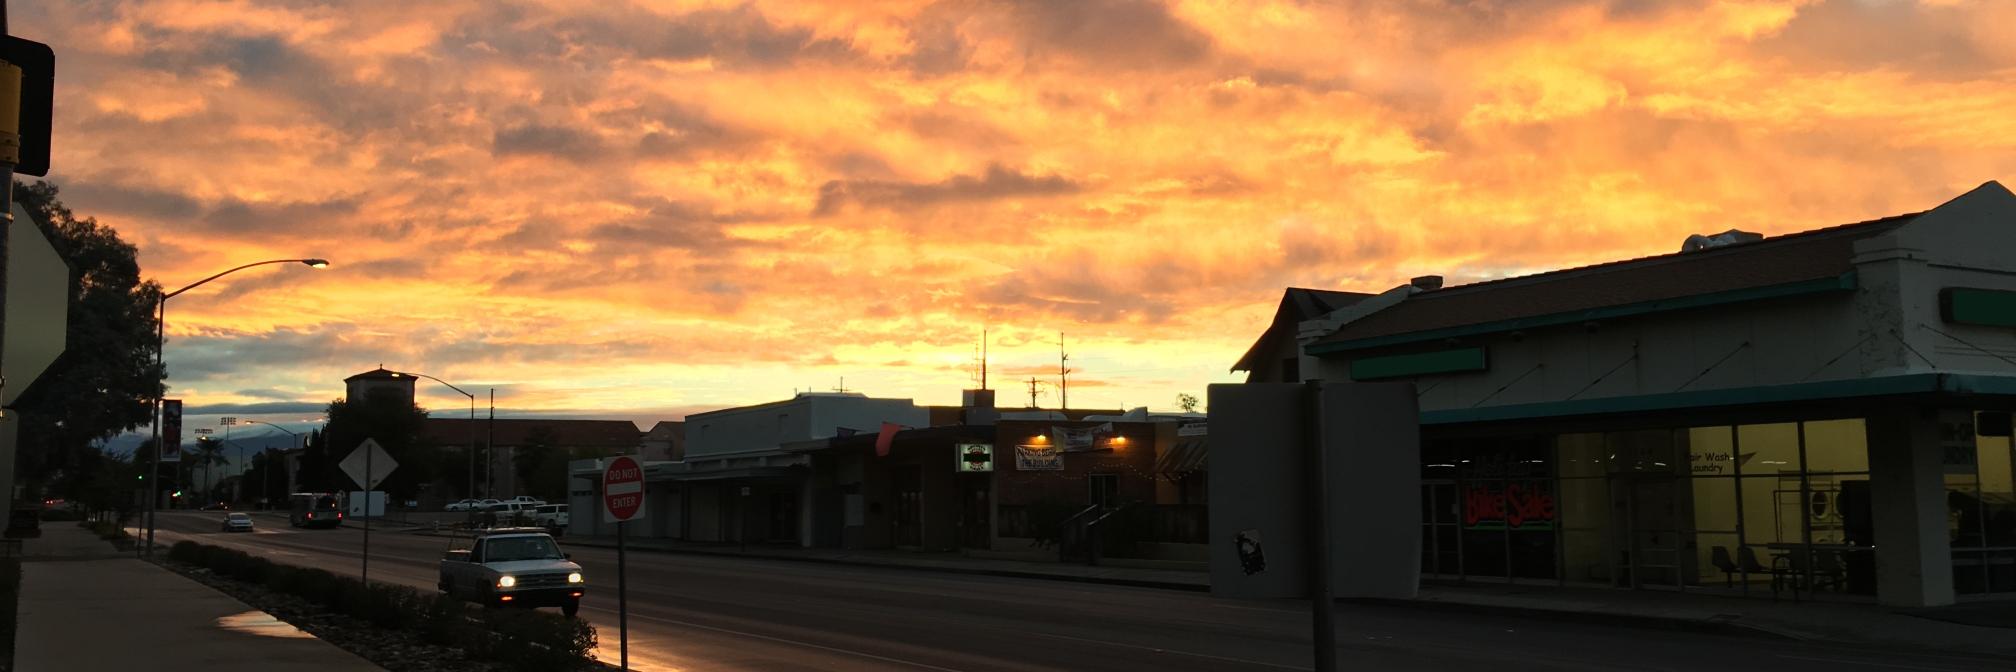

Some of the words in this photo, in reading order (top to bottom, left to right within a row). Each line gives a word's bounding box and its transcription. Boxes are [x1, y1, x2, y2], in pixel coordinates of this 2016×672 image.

[1705, 451, 1730, 462] Wash
[609, 470, 621, 481] DO
[622, 468, 640, 480] NOT
[613, 496, 637, 509] ENTER
[1505, 483, 1553, 527] Sale
